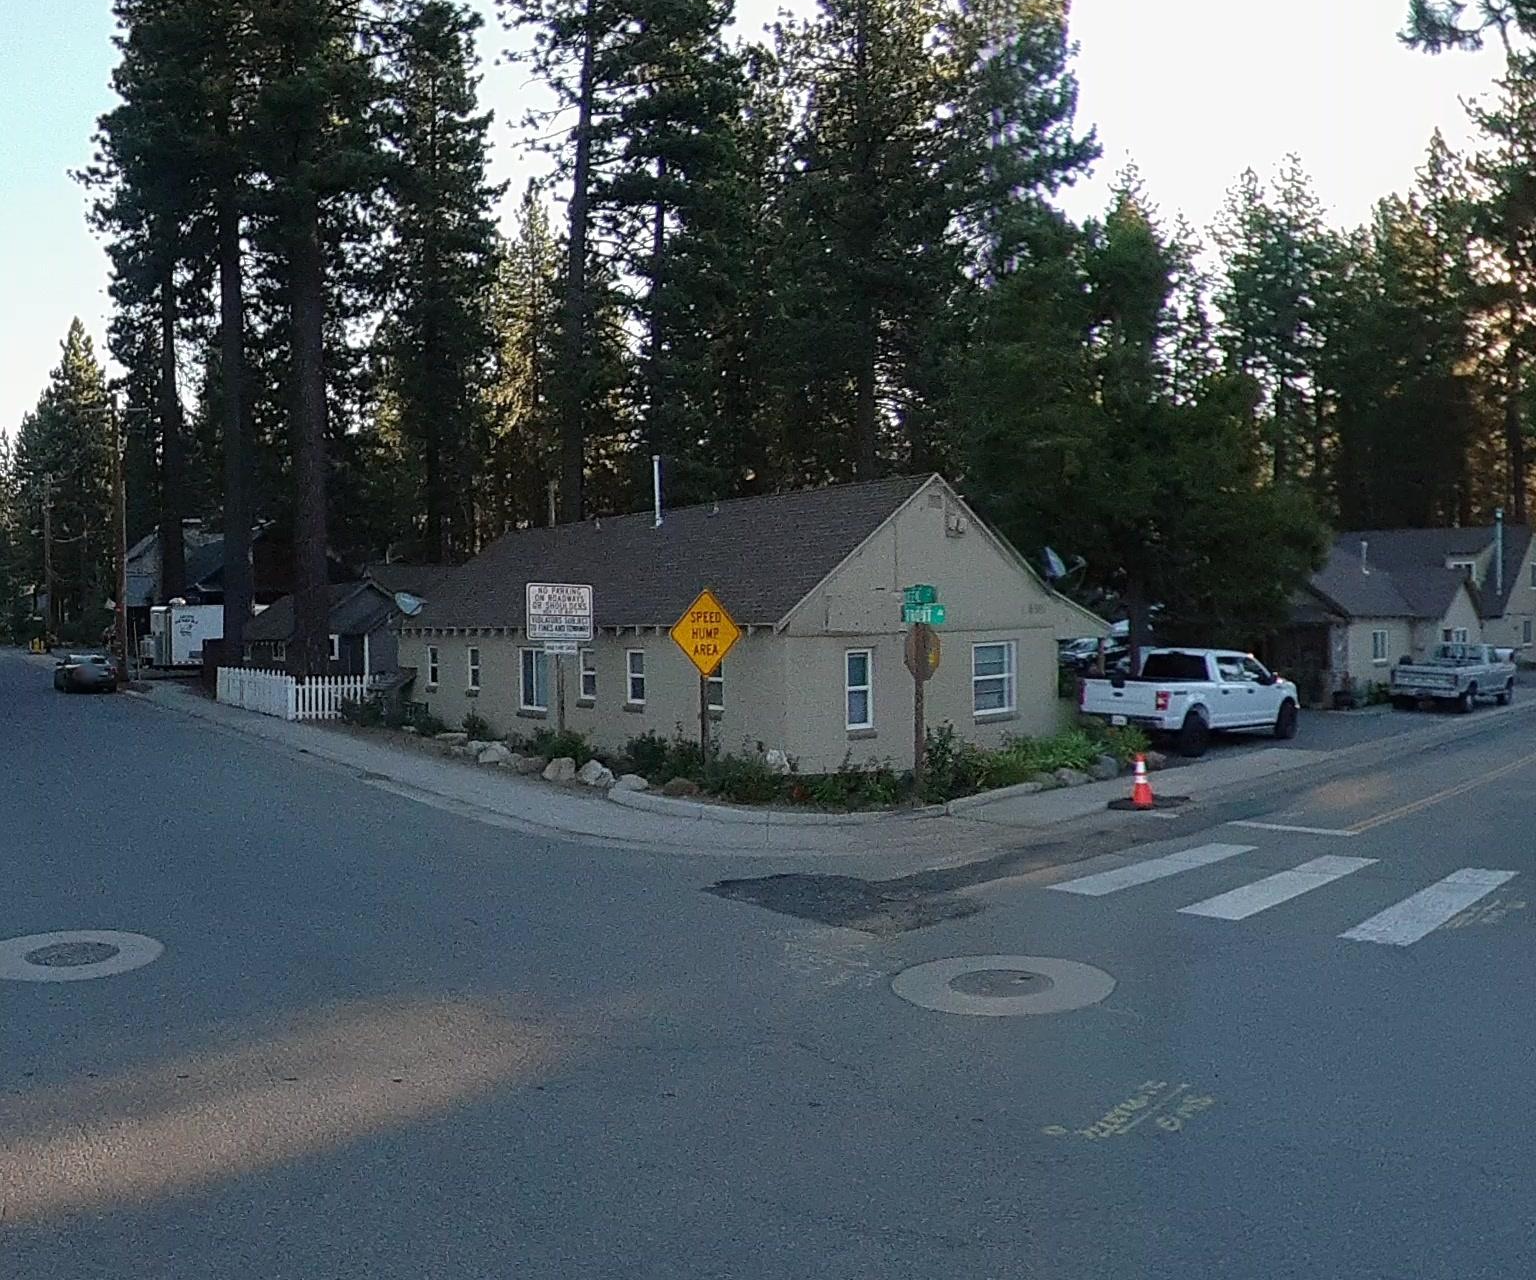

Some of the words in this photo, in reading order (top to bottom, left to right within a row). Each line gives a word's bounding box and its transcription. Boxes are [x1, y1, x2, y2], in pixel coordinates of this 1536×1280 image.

[690, 611, 722, 624] SPEED
[691, 627, 720, 640] HUMP
[693, 643, 719, 657] AREA
